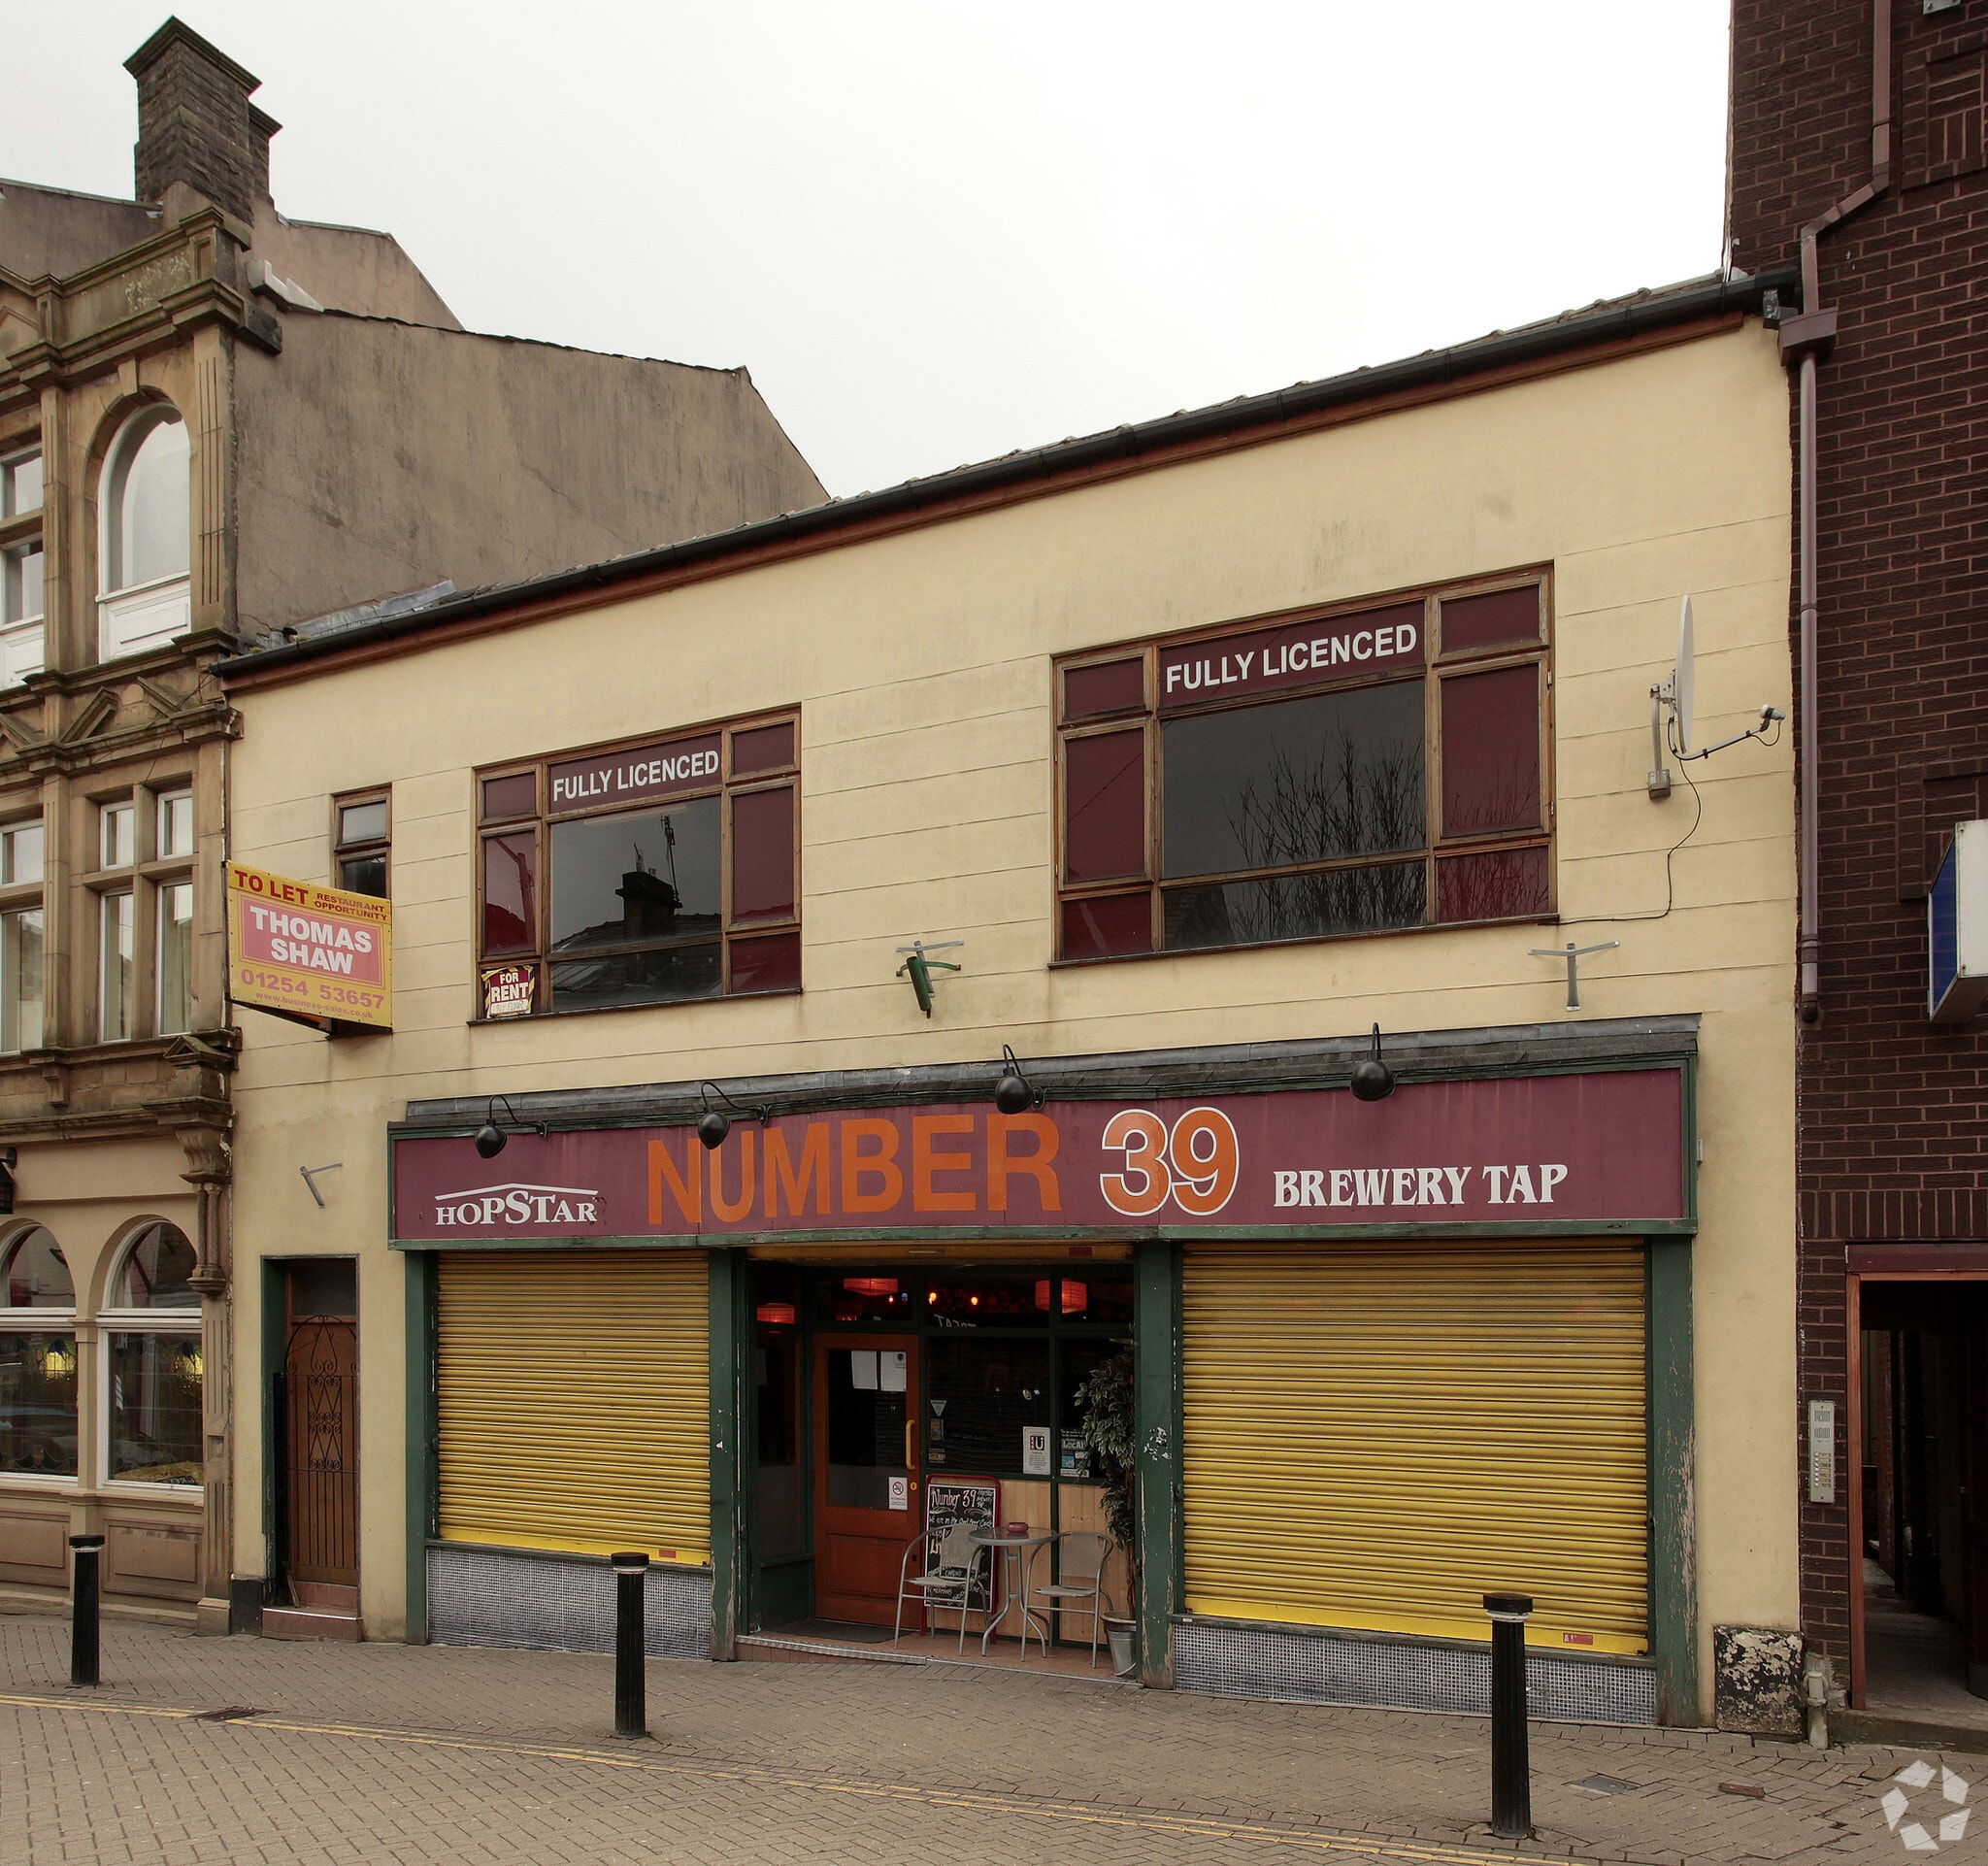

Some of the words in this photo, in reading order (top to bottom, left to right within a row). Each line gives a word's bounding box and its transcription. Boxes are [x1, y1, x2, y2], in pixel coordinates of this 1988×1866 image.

[1167, 651, 1255, 693] FULLY
[1263, 623, 1417, 677] LICENCED
[553, 769, 613, 802] FULLY
[617, 750, 719, 790] LICENCED
[234, 869, 263, 892] TO
[270, 881, 309, 904] LET
[316, 892, 385, 913] RESTAURANT
[315, 900, 387, 921] OPPORTUNITY
[249, 906, 373, 953] THOMAS
[270, 938, 354, 975] SHAW
[241, 969, 309, 996] 01254
[319, 983, 384, 1010] 53657
[490, 982, 529, 1003] RENT
[499, 972, 519, 984] FOR
[254, 991, 374, 1019] www.business-sales.co.uk
[647, 1113, 1062, 1225] NUMBER
[1100, 1106, 1241, 1216] 39
[1273, 1166, 1472, 1207] BREWERY
[1481, 1164, 1569, 1204] TAP
[434, 1189, 598, 1225] HOPSTAR
[962, 1489, 977, 1508] 39
